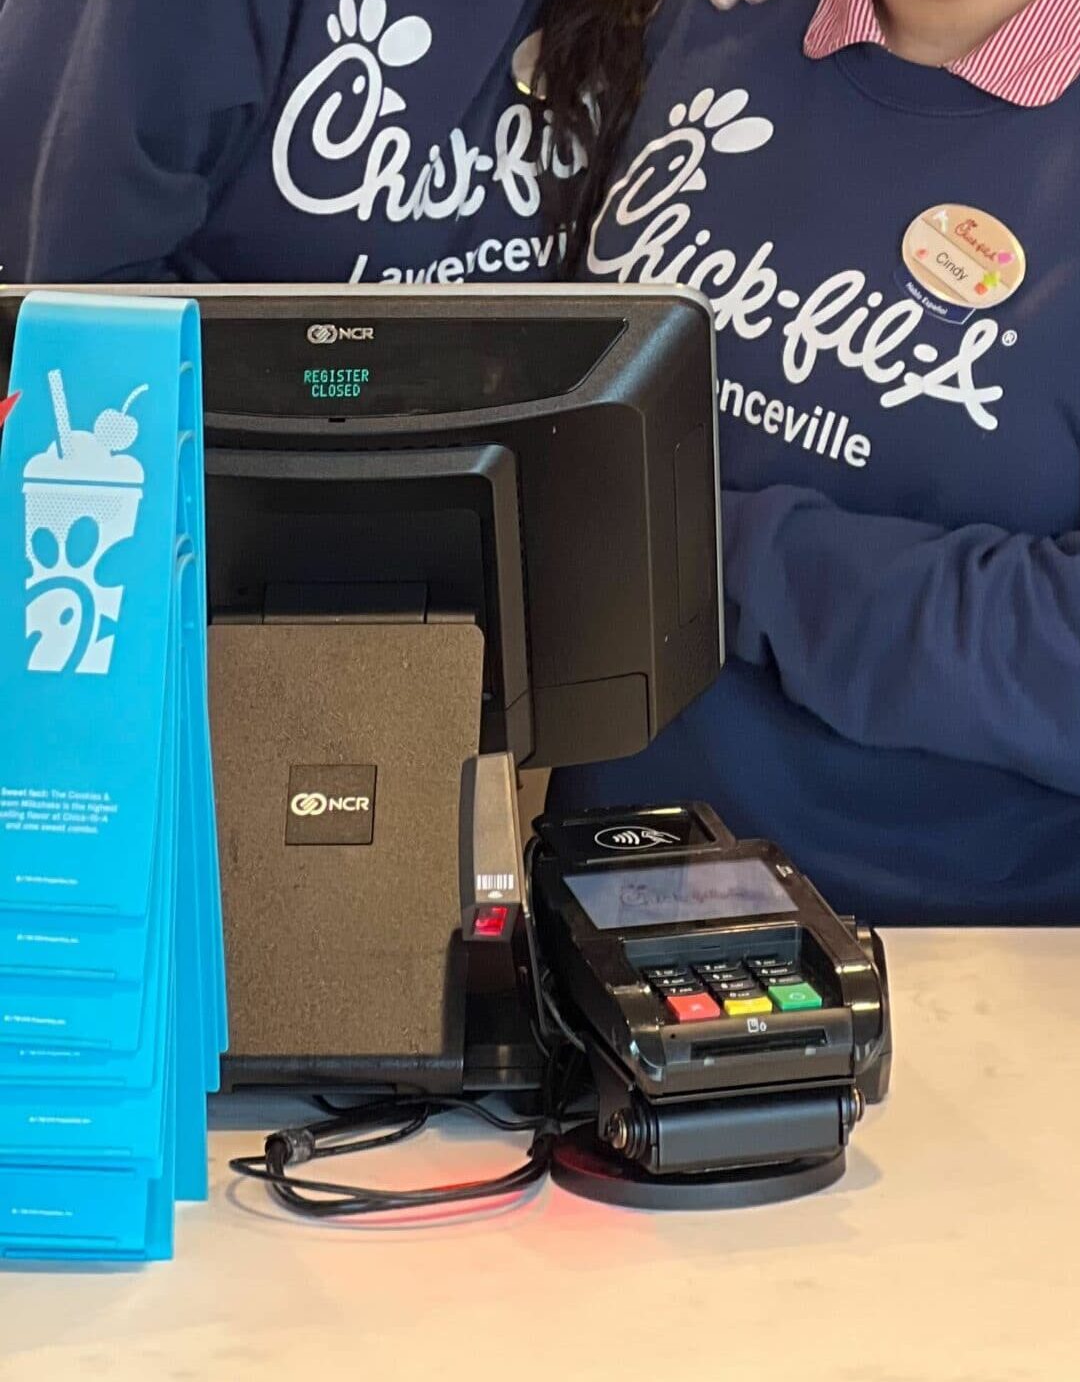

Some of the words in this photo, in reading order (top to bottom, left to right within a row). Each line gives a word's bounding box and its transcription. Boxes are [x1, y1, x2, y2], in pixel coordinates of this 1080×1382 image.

[936, 252, 968, 281] Cindy
[338, 327, 374, 340] NCR
[304, 369, 369, 383] REGISTER
[311, 384, 360, 398] CLOSED
[1, 787, 27, 797] Sweet
[51, 789, 66, 799] The
[328, 797, 369, 811] NCR
[5, 822, 21, 831] and
